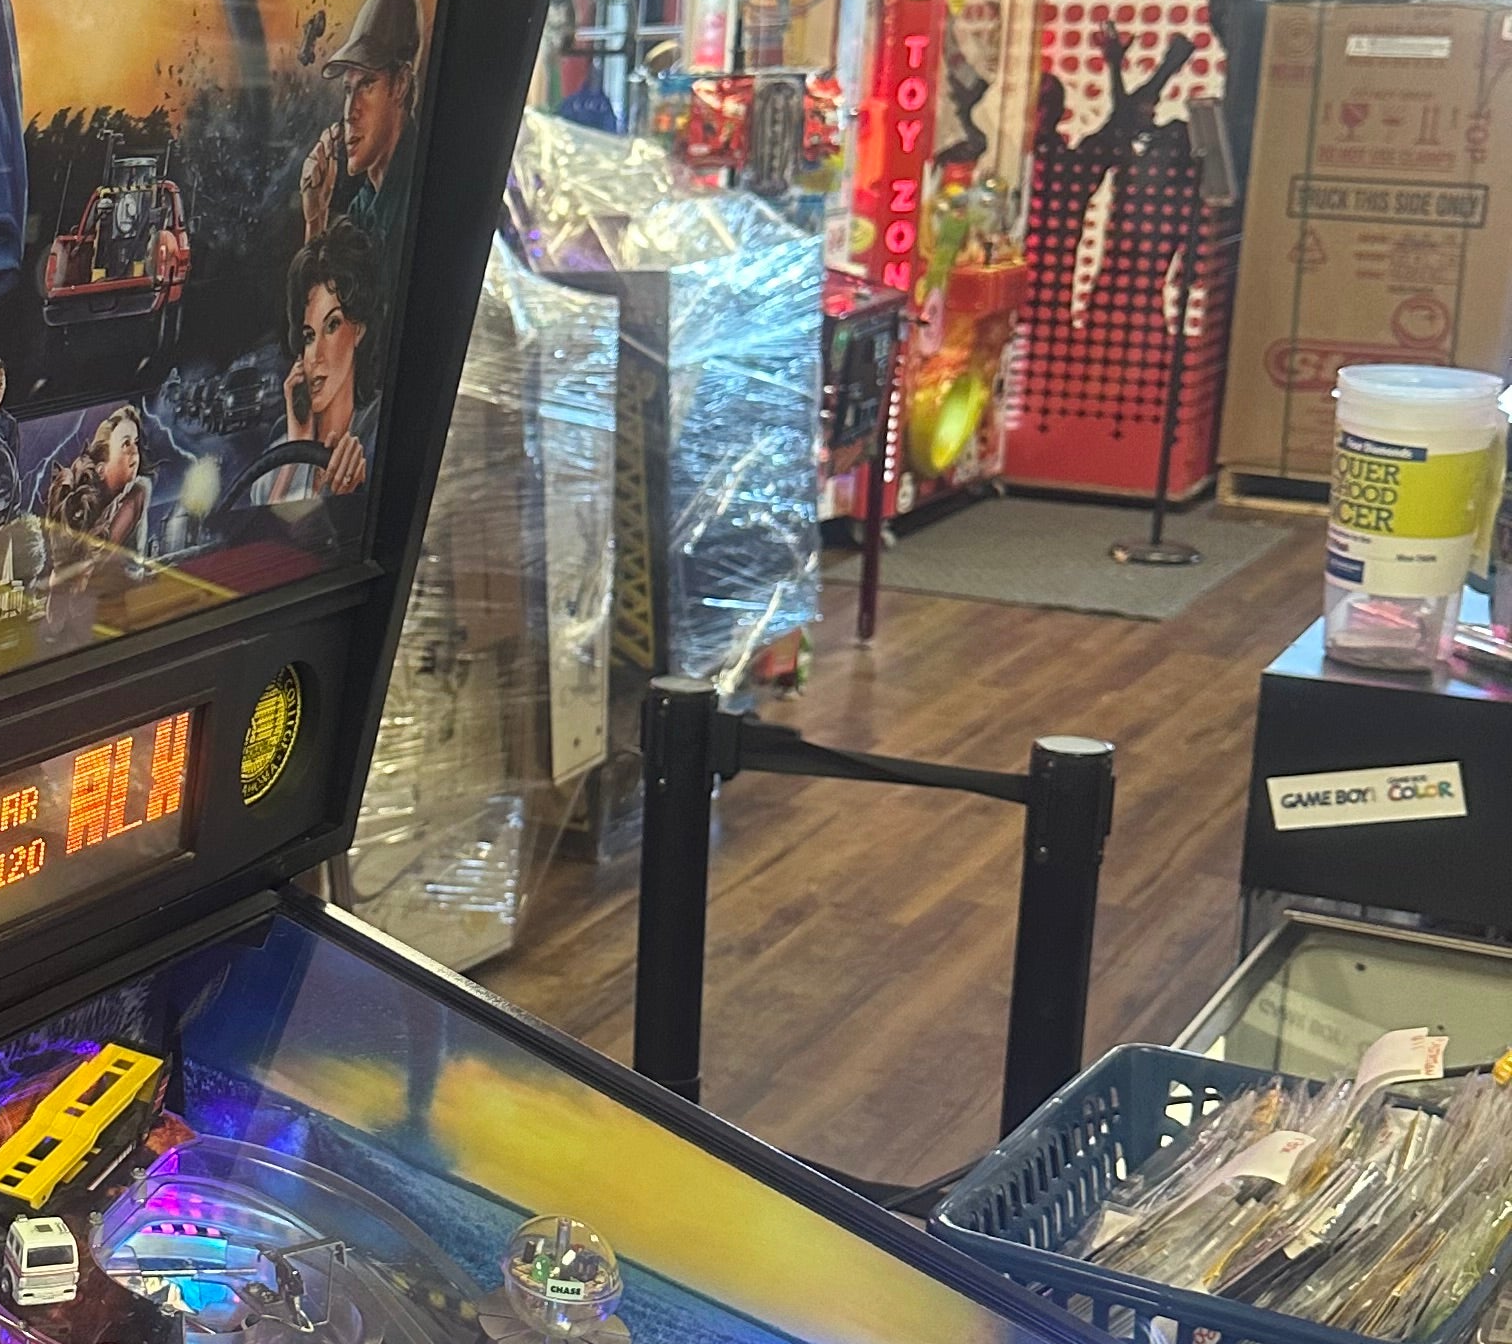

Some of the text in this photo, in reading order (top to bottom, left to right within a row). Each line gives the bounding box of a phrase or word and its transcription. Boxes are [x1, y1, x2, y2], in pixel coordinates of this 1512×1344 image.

[897, 35, 930, 153] TOY
[1280, 786, 1368, 809] GAME BOY
[1388, 780, 1455, 802] COLOR
[550, 1285, 582, 1296] CHASE
